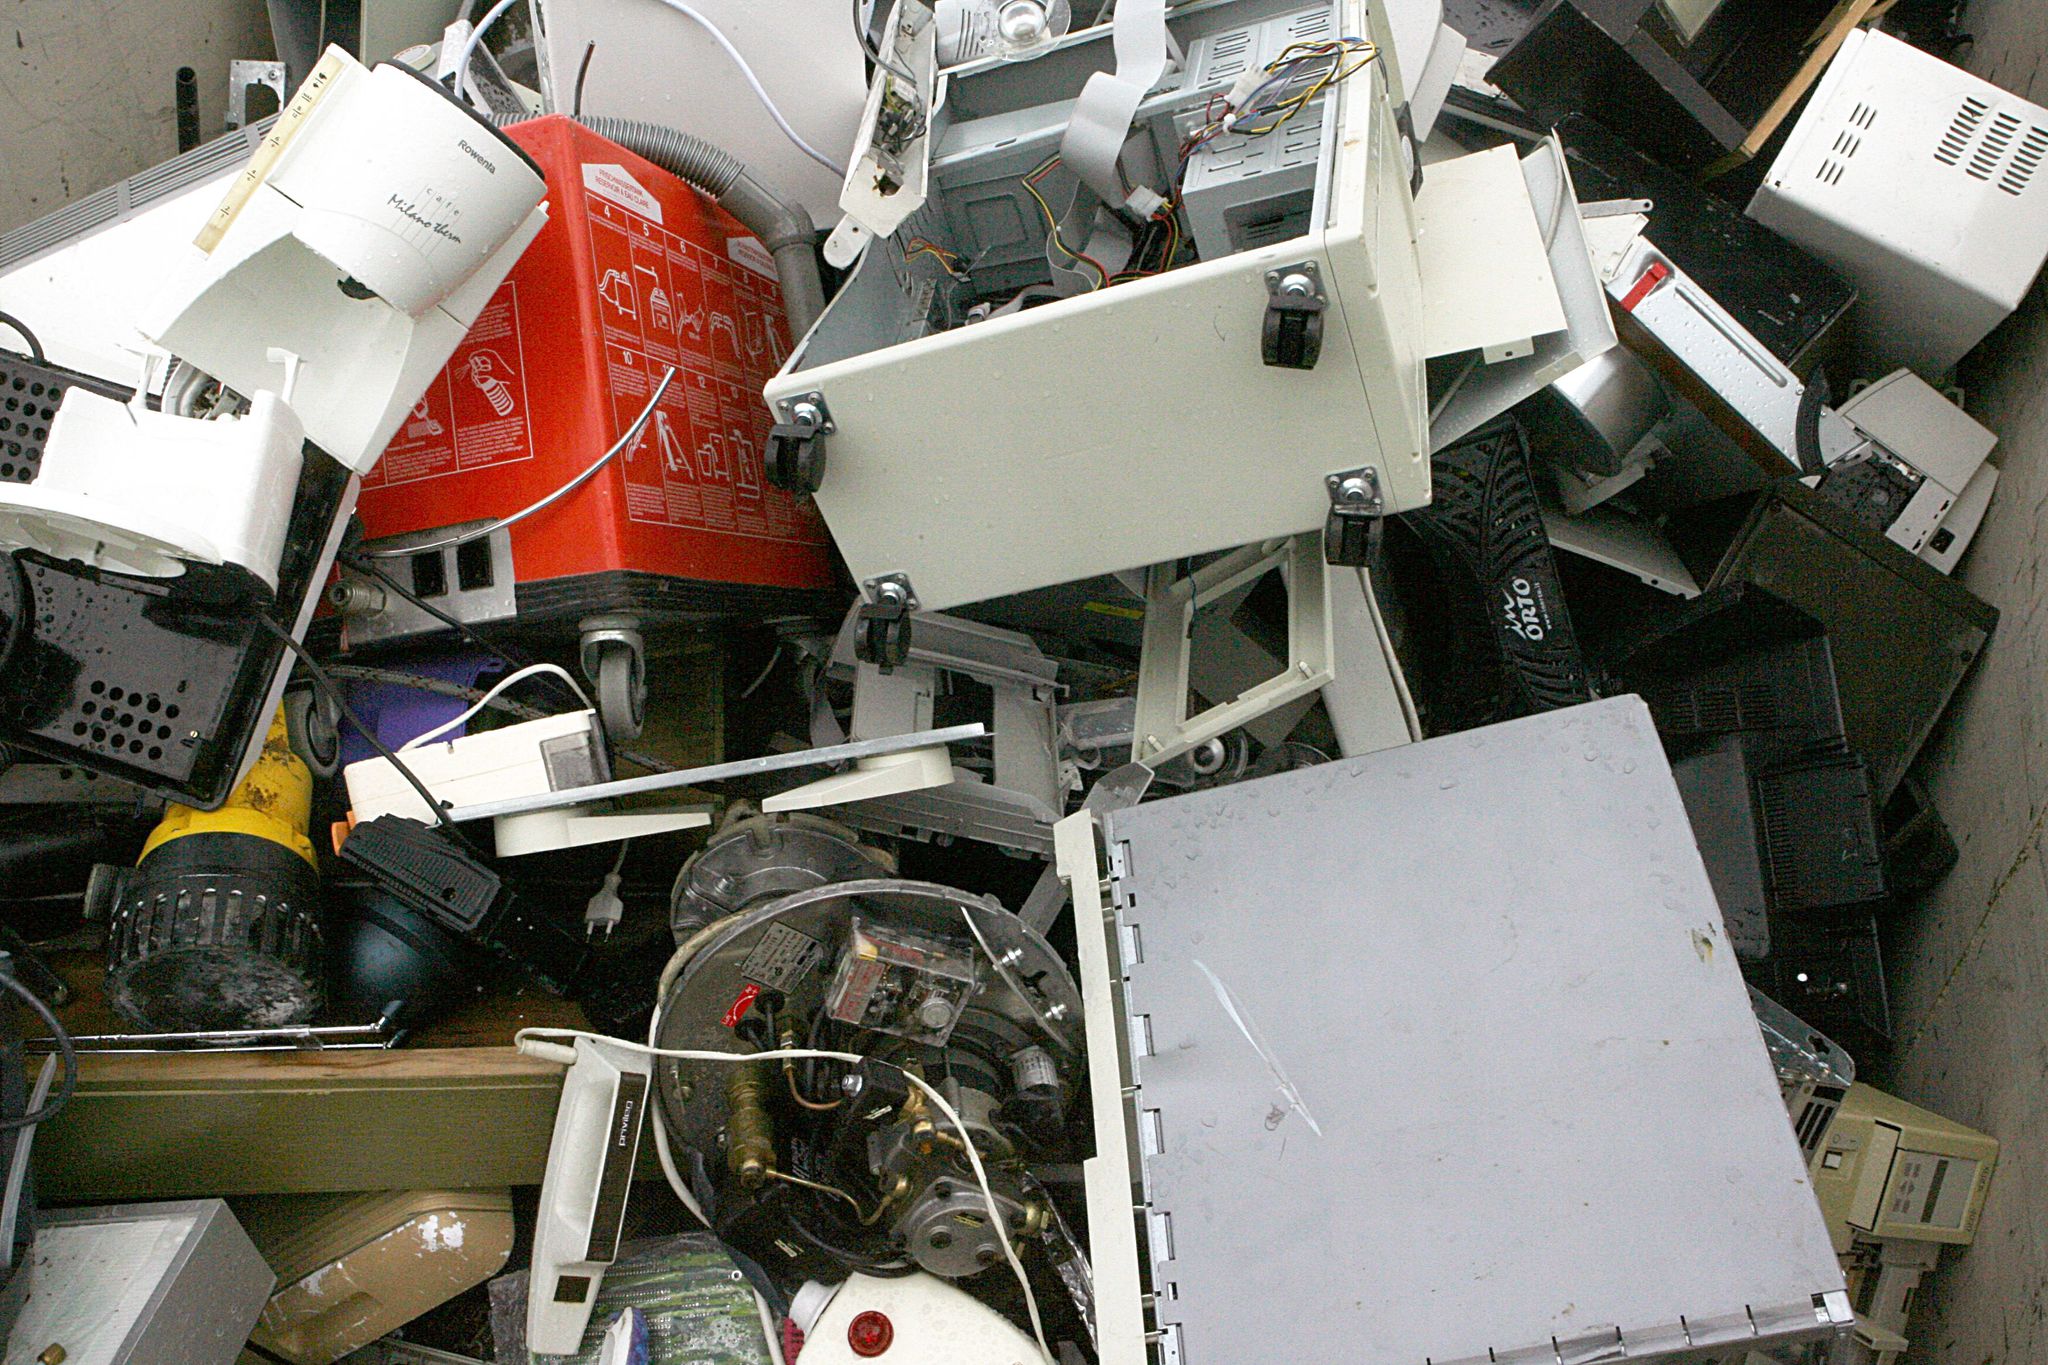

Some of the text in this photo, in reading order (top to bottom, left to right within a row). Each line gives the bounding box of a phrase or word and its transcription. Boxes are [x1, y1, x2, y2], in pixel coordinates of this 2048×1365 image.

[458, 139, 496, 175] Rowenta
[387, 194, 461, 243] Milano therm
[604, 204, 611, 218] 4
[643, 222, 650, 236] 5
[680, 240, 686, 253] 6
[622, 351, 633, 366] 10
[1512, 578, 1544, 641] ORTO
